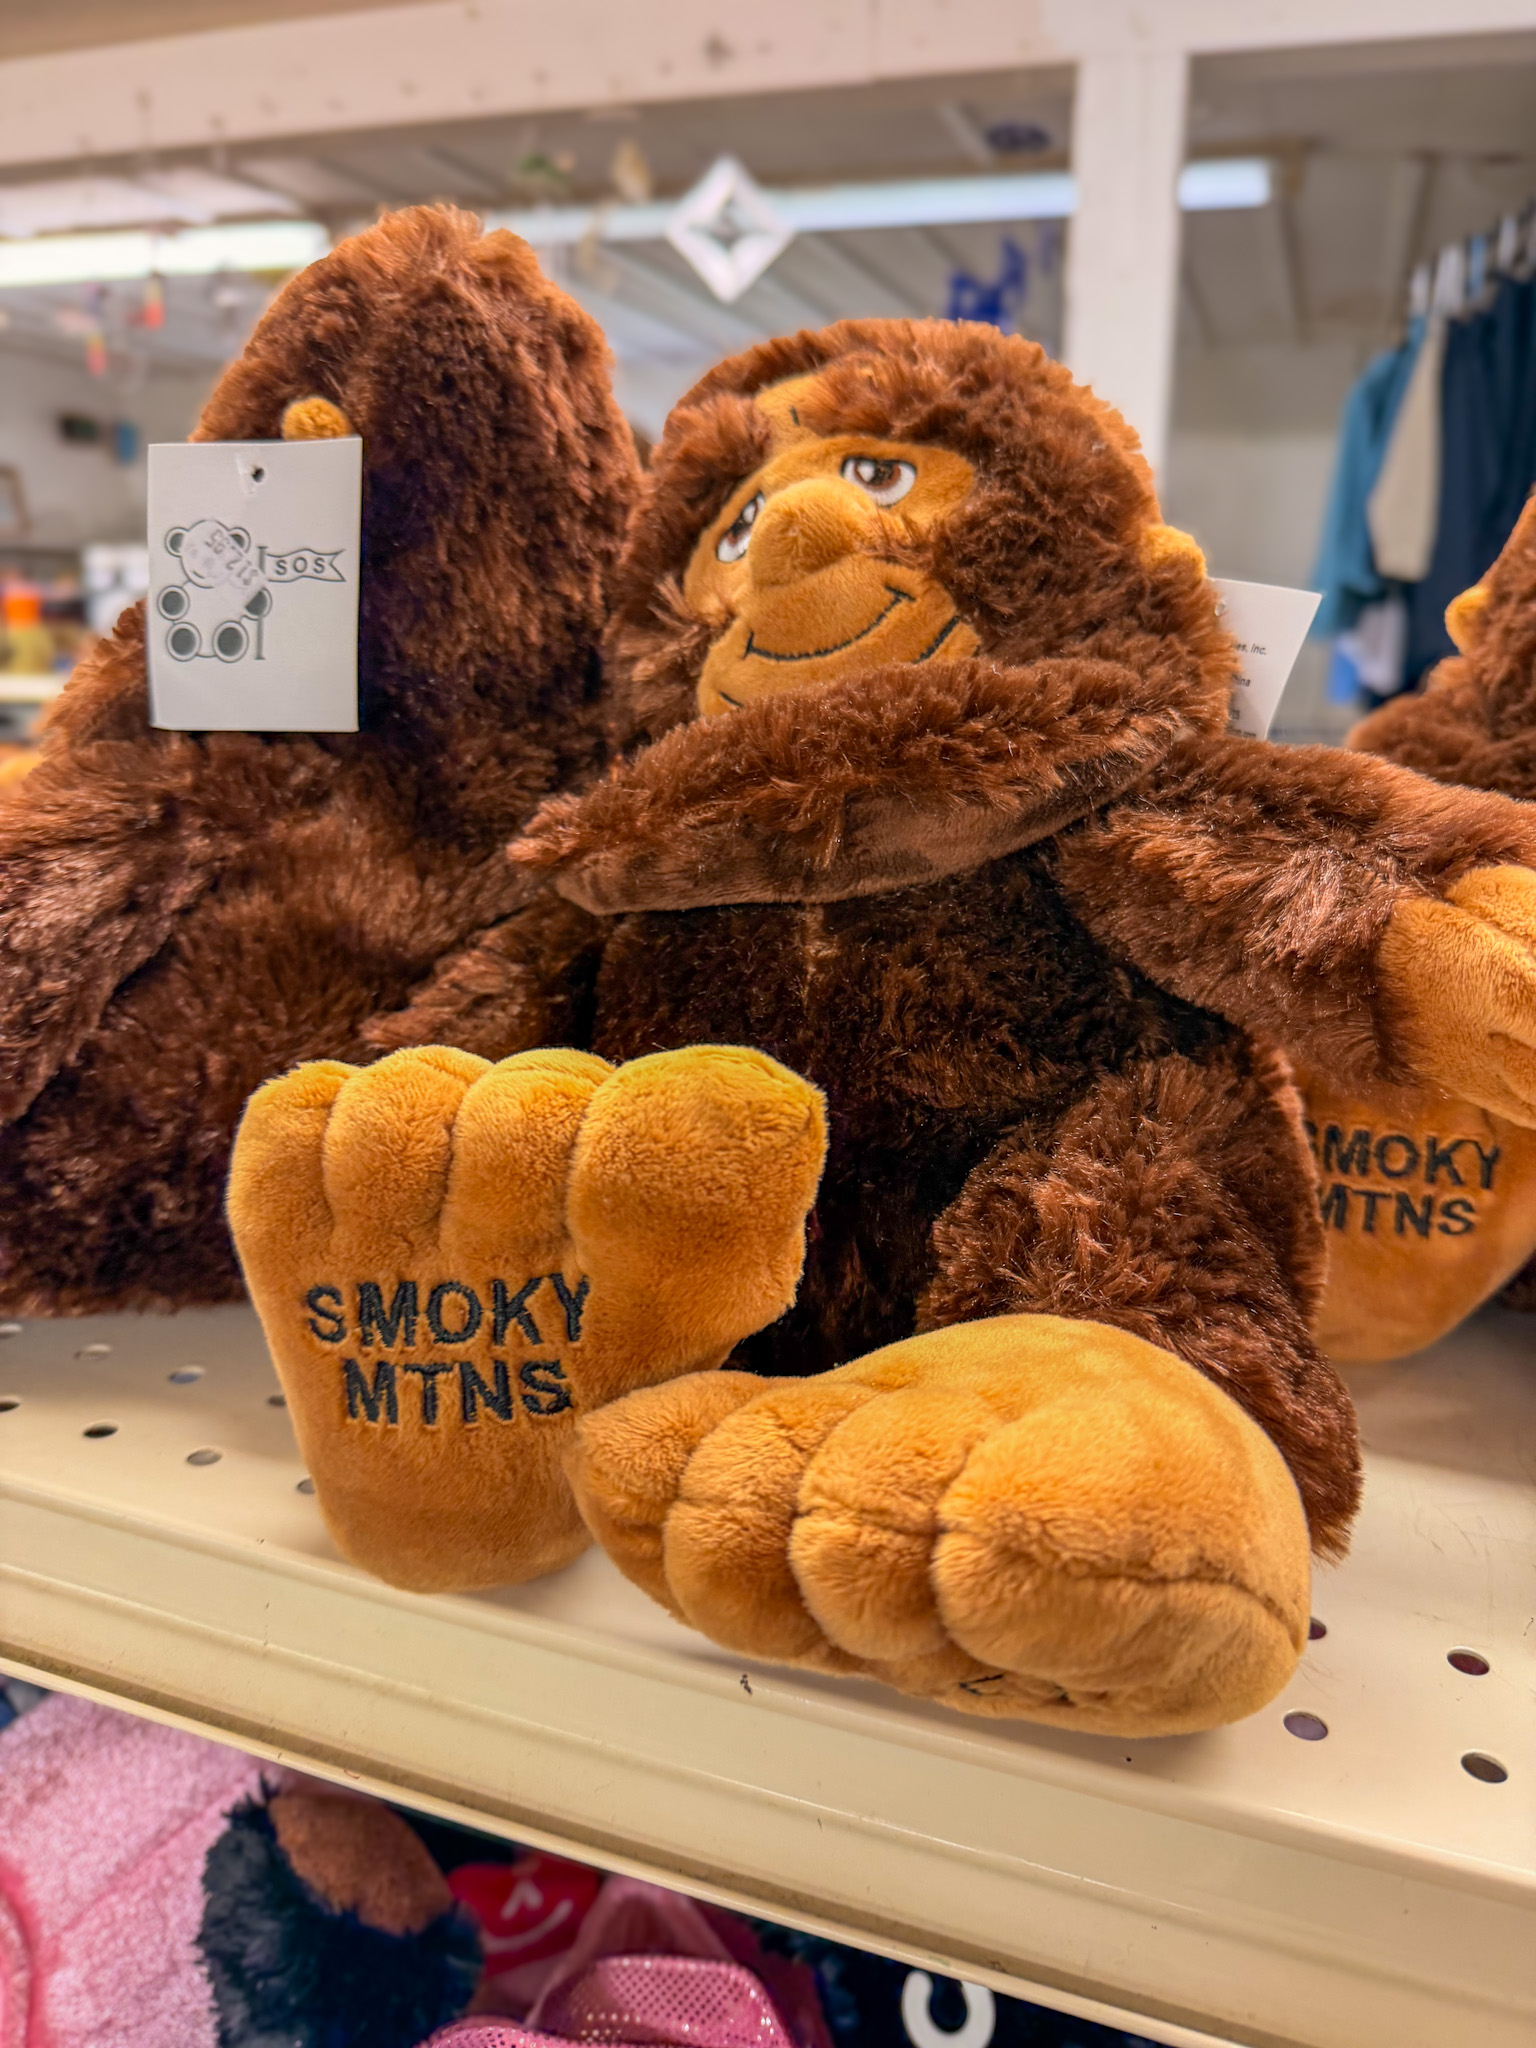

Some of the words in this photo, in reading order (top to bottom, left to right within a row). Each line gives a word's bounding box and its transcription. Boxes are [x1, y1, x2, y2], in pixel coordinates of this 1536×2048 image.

[274, 556, 325, 576] SOS
[1250, 643, 1267, 656] Inc.
[305, 1272, 591, 1348] SMOKY
[343, 1357, 574, 1425] MTNS
